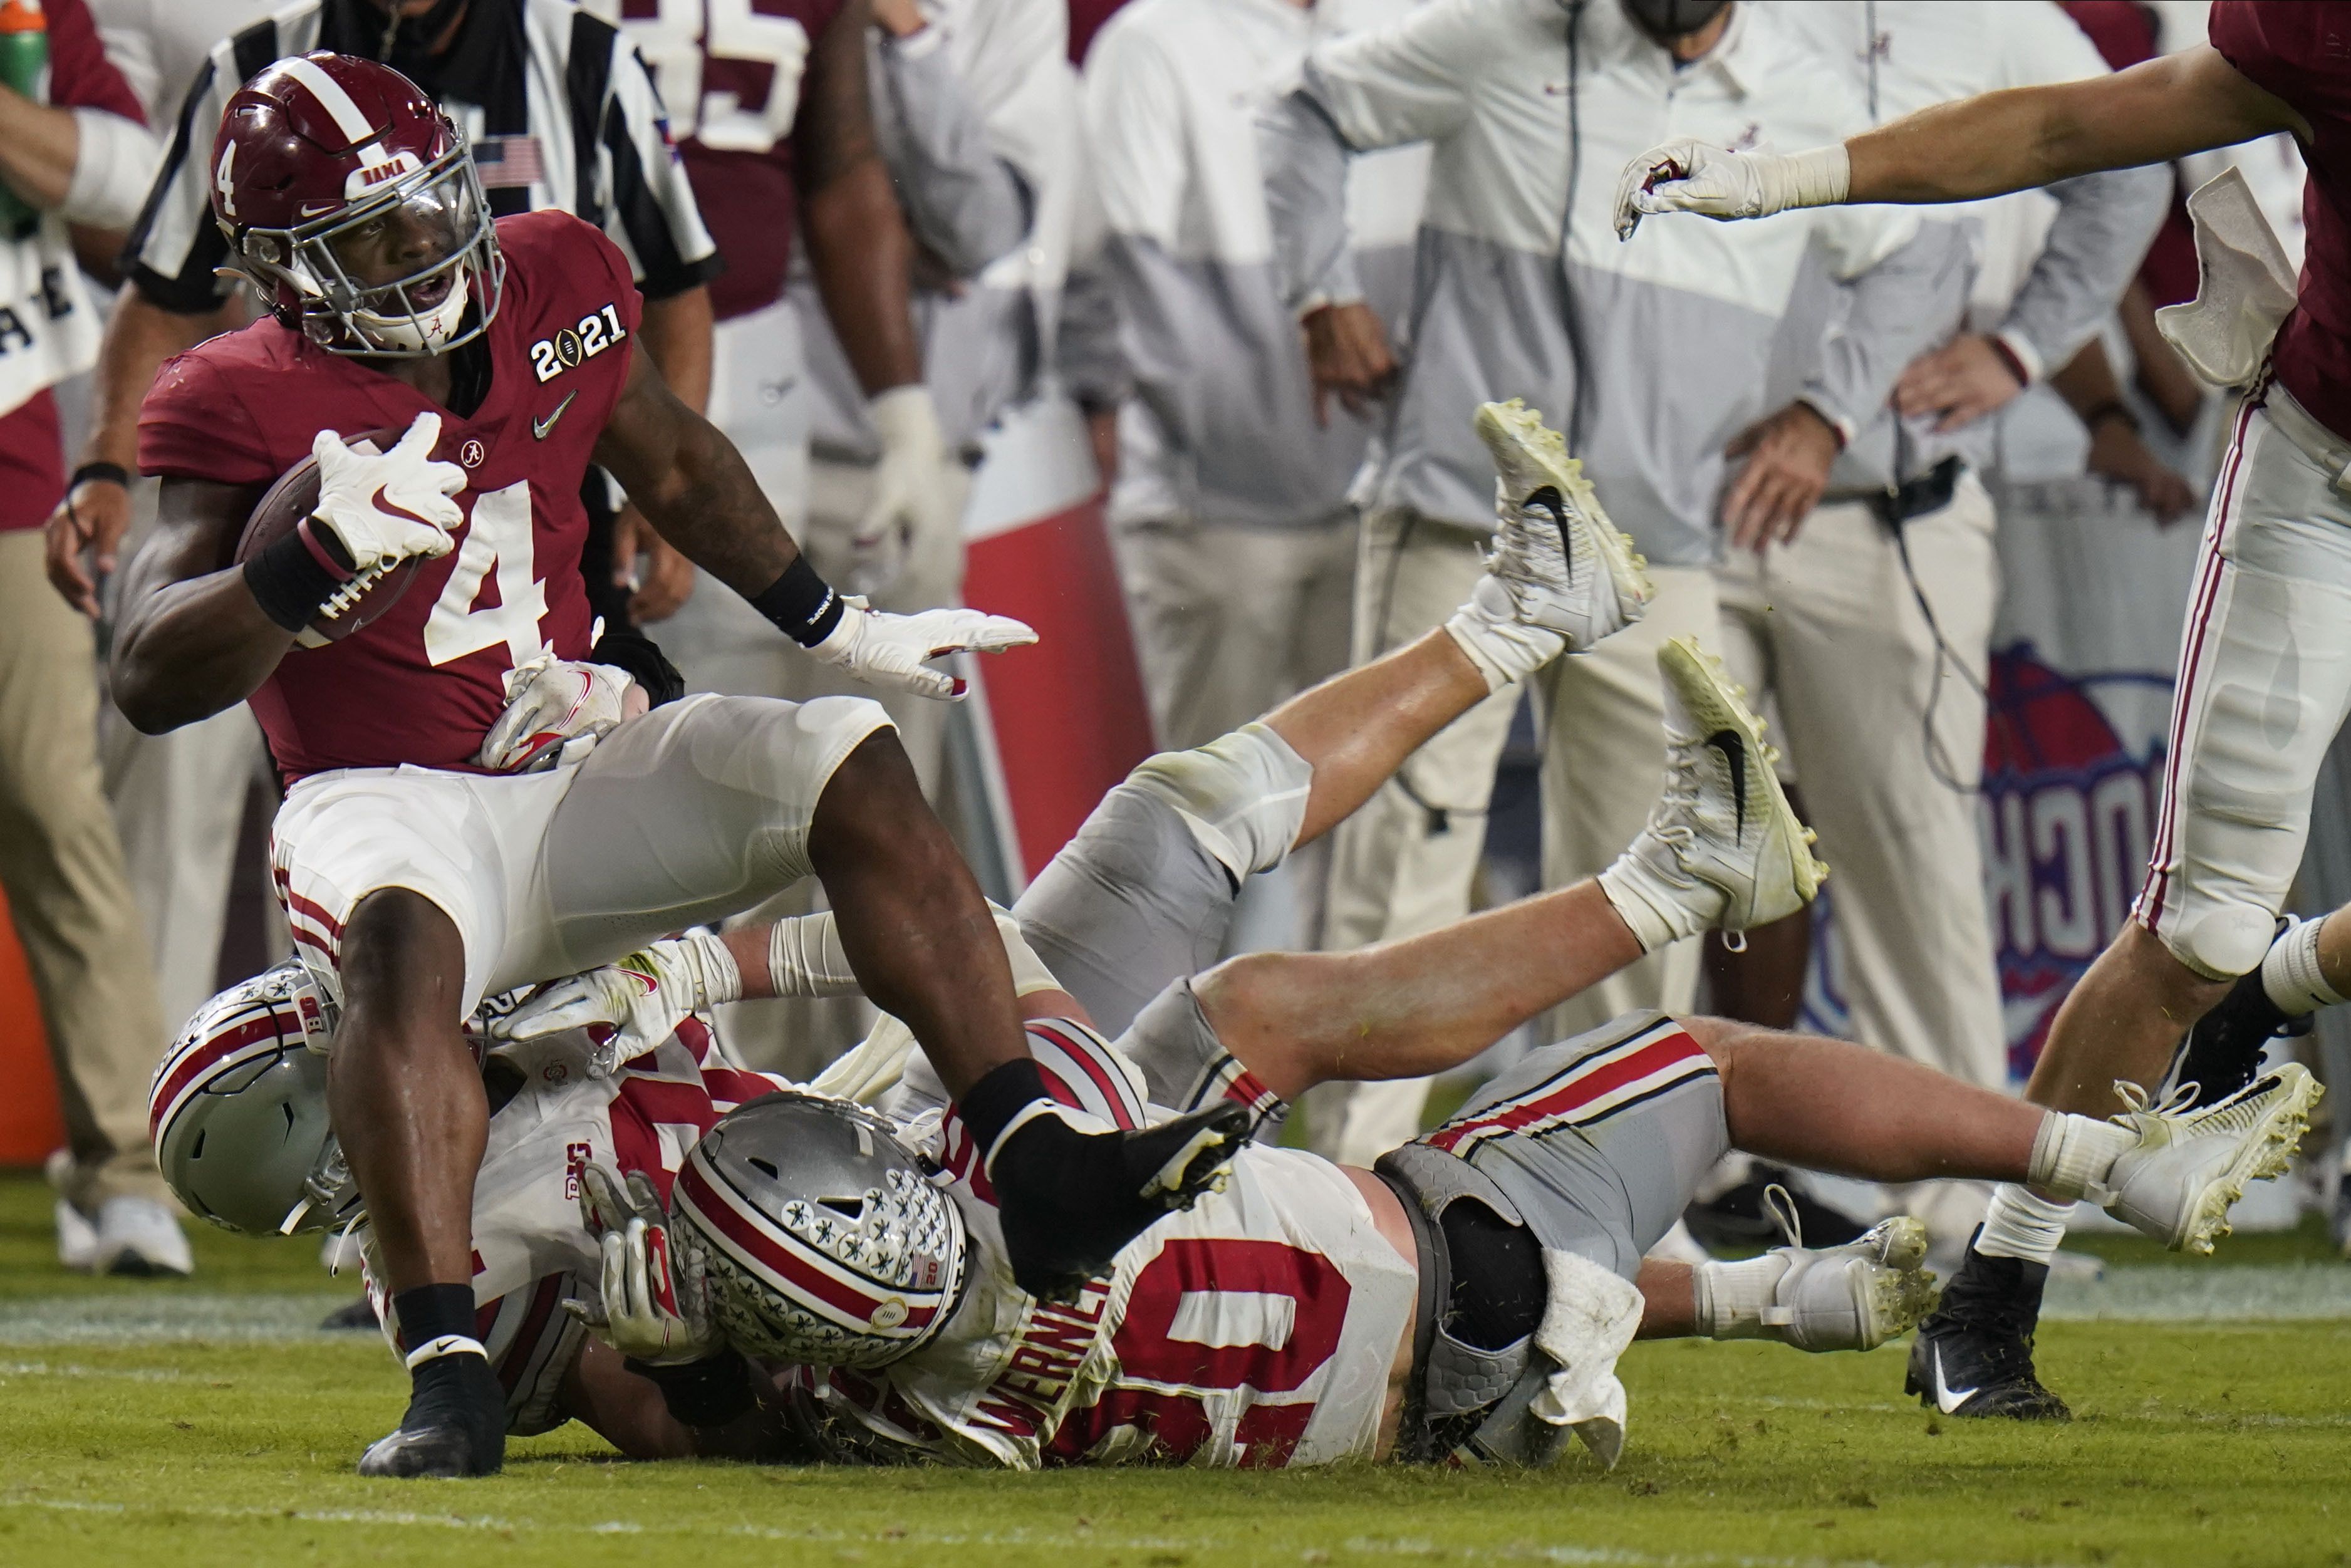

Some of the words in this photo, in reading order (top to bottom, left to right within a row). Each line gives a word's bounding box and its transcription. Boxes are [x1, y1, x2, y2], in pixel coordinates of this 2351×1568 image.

[217, 138, 237, 217] 4
[361, 158, 407, 186] BAMA
[530, 303, 627, 383] 2021
[423, 478, 554, 708] 4
[925, 1261, 938, 1286] 20
